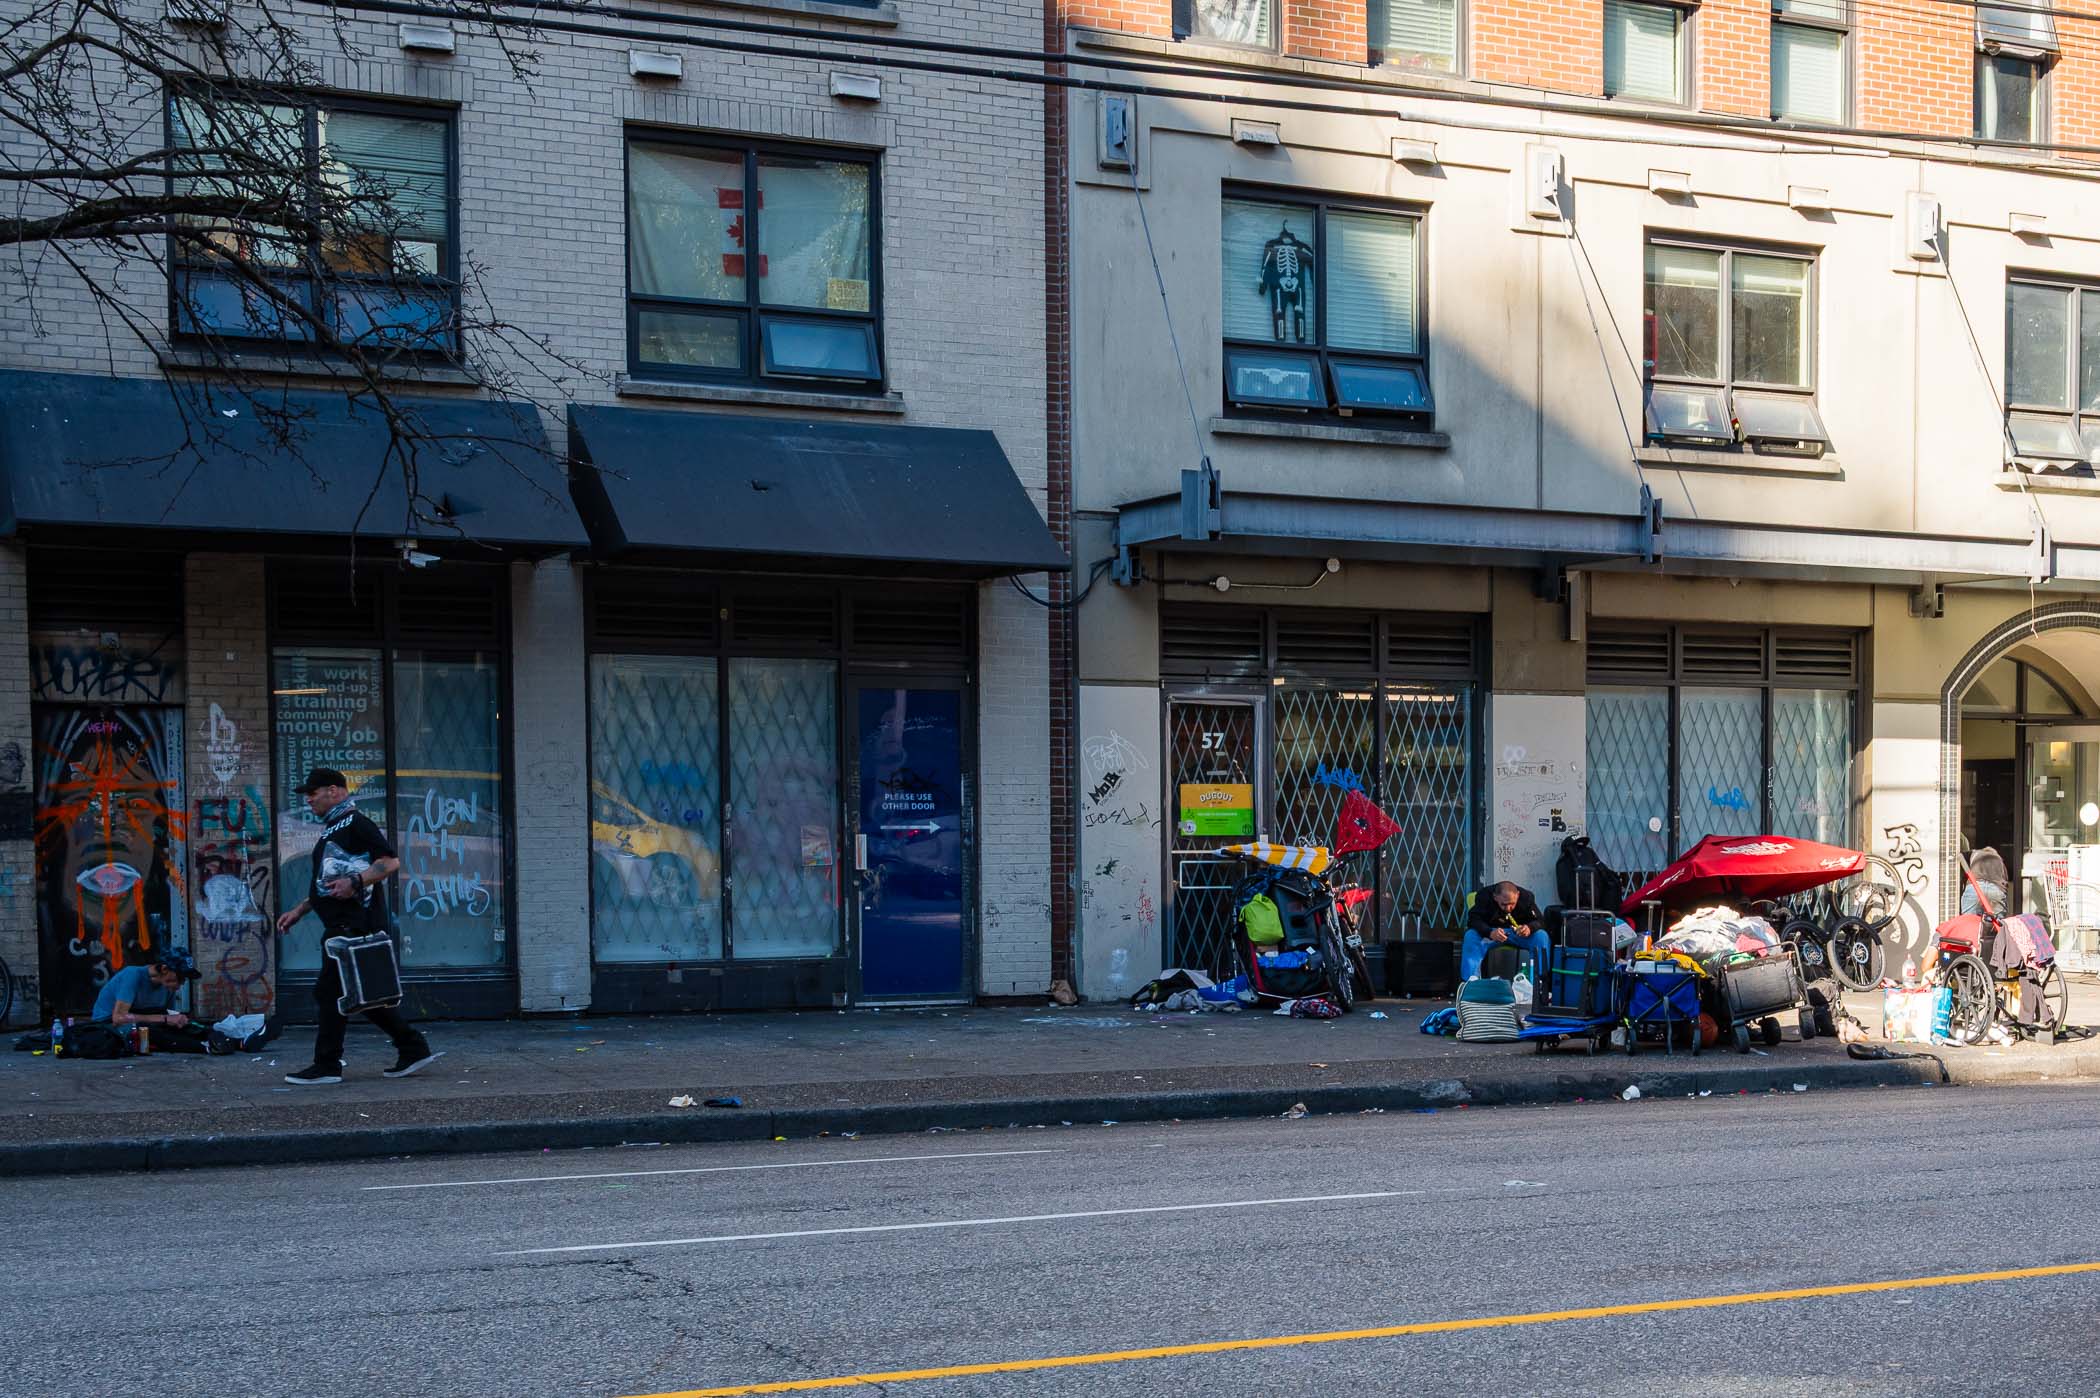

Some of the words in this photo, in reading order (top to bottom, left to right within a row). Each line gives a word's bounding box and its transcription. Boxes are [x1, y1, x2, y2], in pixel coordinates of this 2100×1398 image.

[323, 665, 369, 680] work
[294, 693, 368, 712] training
[276, 710, 353, 721] community
[275, 721, 344, 736] money
[301, 736, 336, 747] drive
[344, 726, 378, 747] job
[1201, 732, 1225, 749] 57
[314, 748, 385, 761] success
[884, 793, 915, 801] PLEASE
[916, 793, 933, 801] USE
[881, 802, 910, 811] OTHER
[911, 802, 936, 811] DOOR
